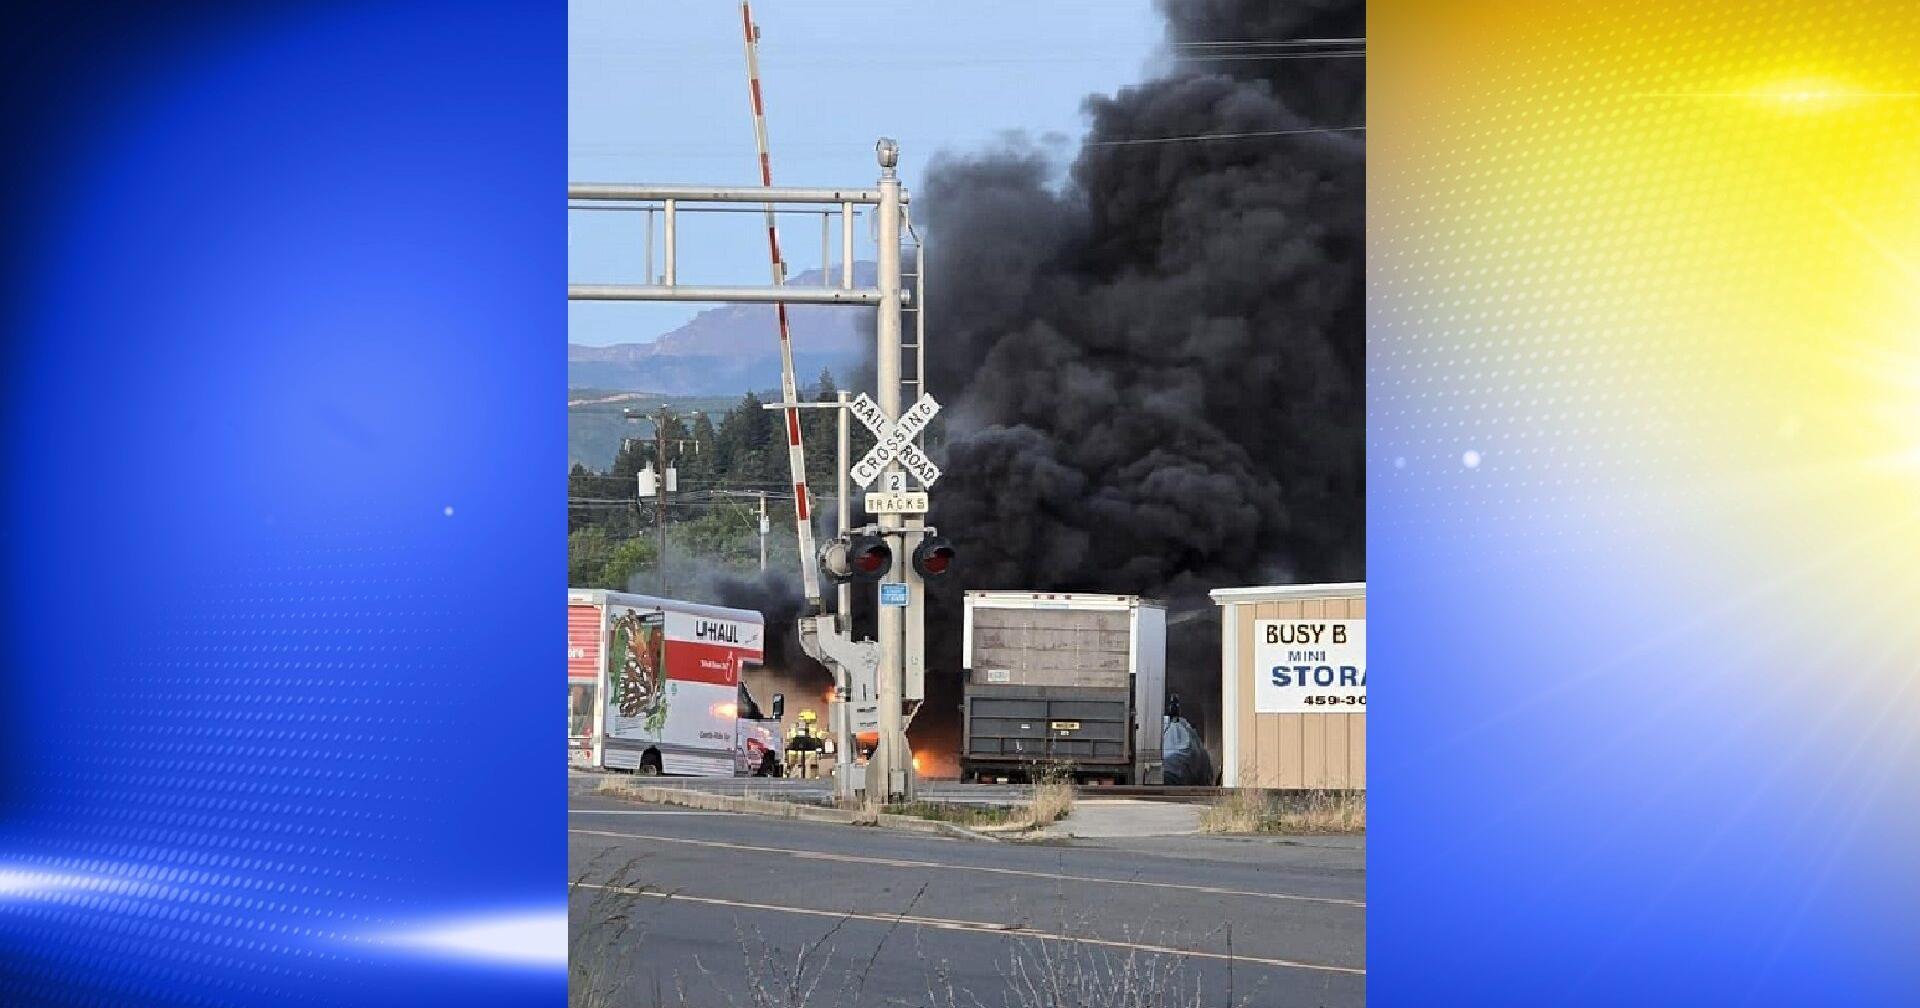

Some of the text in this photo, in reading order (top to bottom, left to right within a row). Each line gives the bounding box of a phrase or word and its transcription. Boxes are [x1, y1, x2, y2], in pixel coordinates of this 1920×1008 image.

[854, 398, 935, 482] RAIL ROAD
[857, 403, 931, 478] CROSSING
[891, 475, 900, 491] 2
[868, 499, 925, 510] TRACKS
[696, 620, 739, 643] U-HAUL
[1266, 624, 1347, 644] BUSY B
[1288, 651, 1326, 662] MINI
[1272, 666, 1366, 687] STOR
